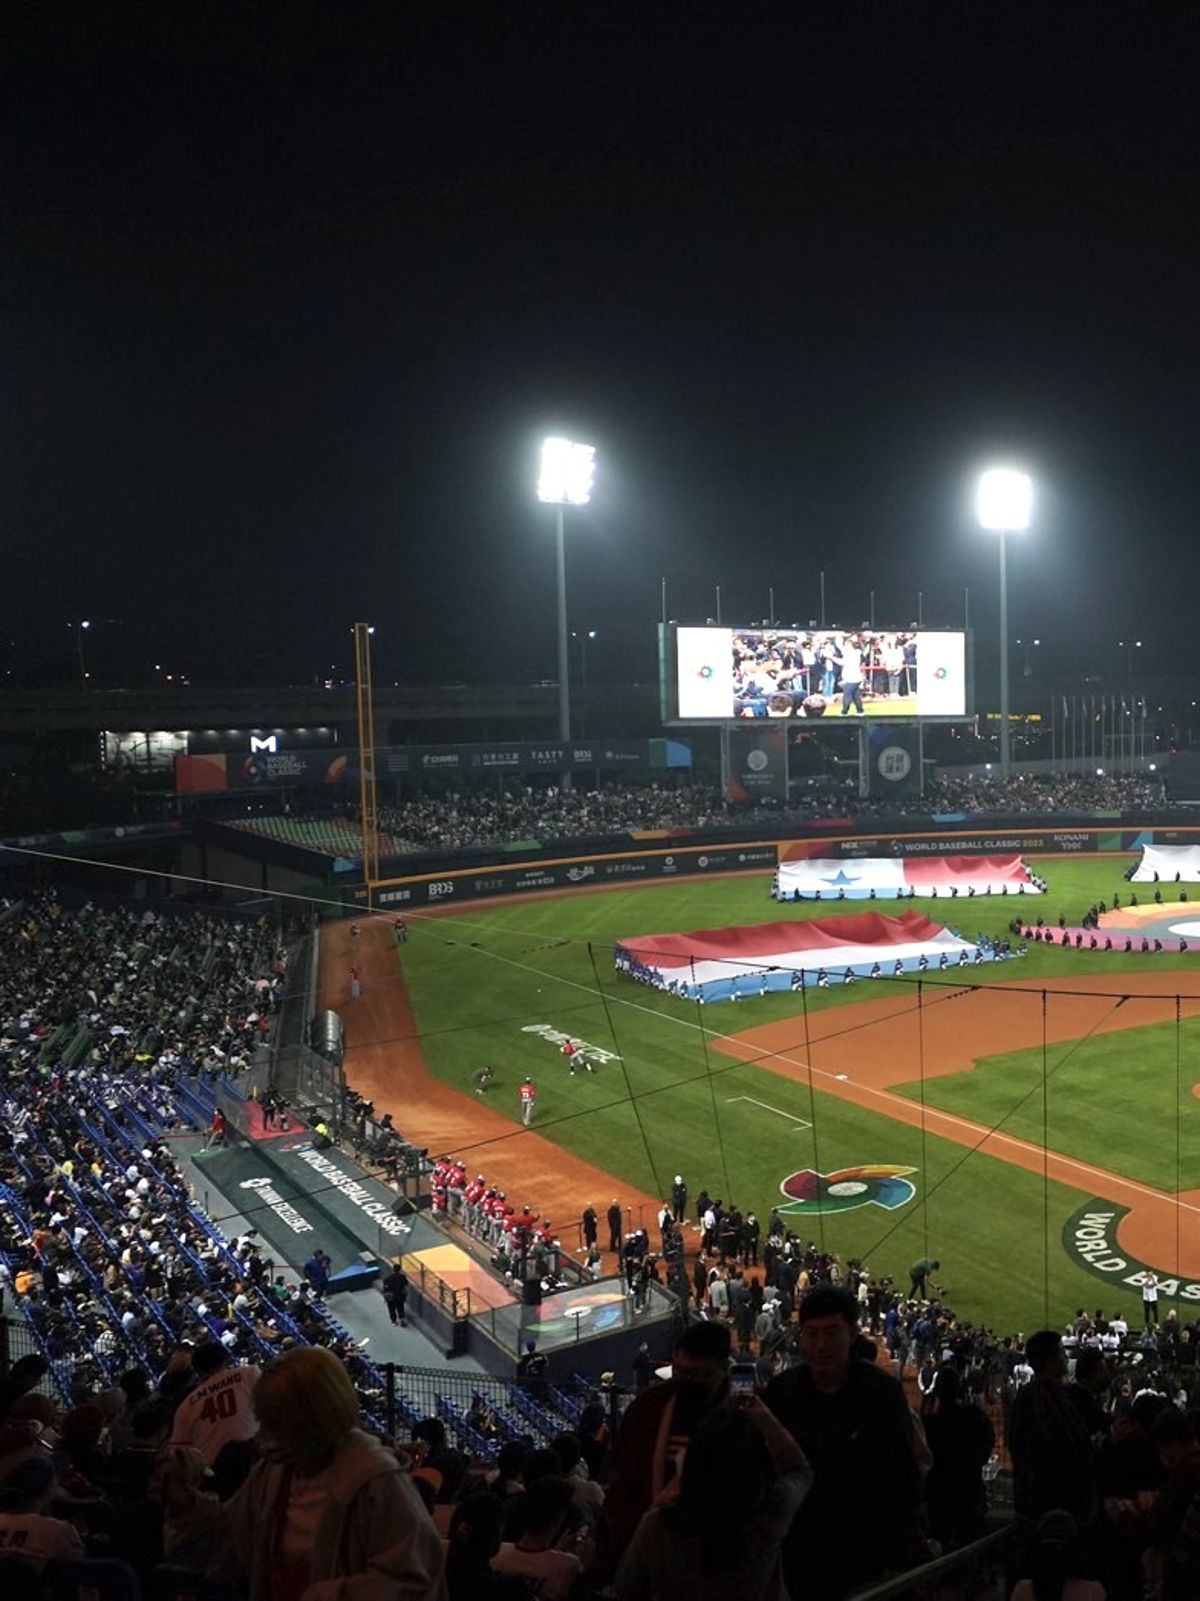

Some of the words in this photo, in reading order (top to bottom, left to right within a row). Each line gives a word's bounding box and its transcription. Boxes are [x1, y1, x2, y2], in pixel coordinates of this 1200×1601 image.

[905, 843, 937, 851] WORLD
[939, 841, 983, 850] BASEBALL
[984, 840, 1021, 848] CLASSIC
[1022, 839, 1044, 847] 2023
[1054, 833, 1089, 841] KONAMI
[297, 1149, 338, 1173] WORLD
[322, 1170, 375, 1206] BASEBALL
[361, 1203, 412, 1236] CLASSIC
[1075, 1212, 1128, 1272] WORLD
[200, 1388, 237, 1424] 40
